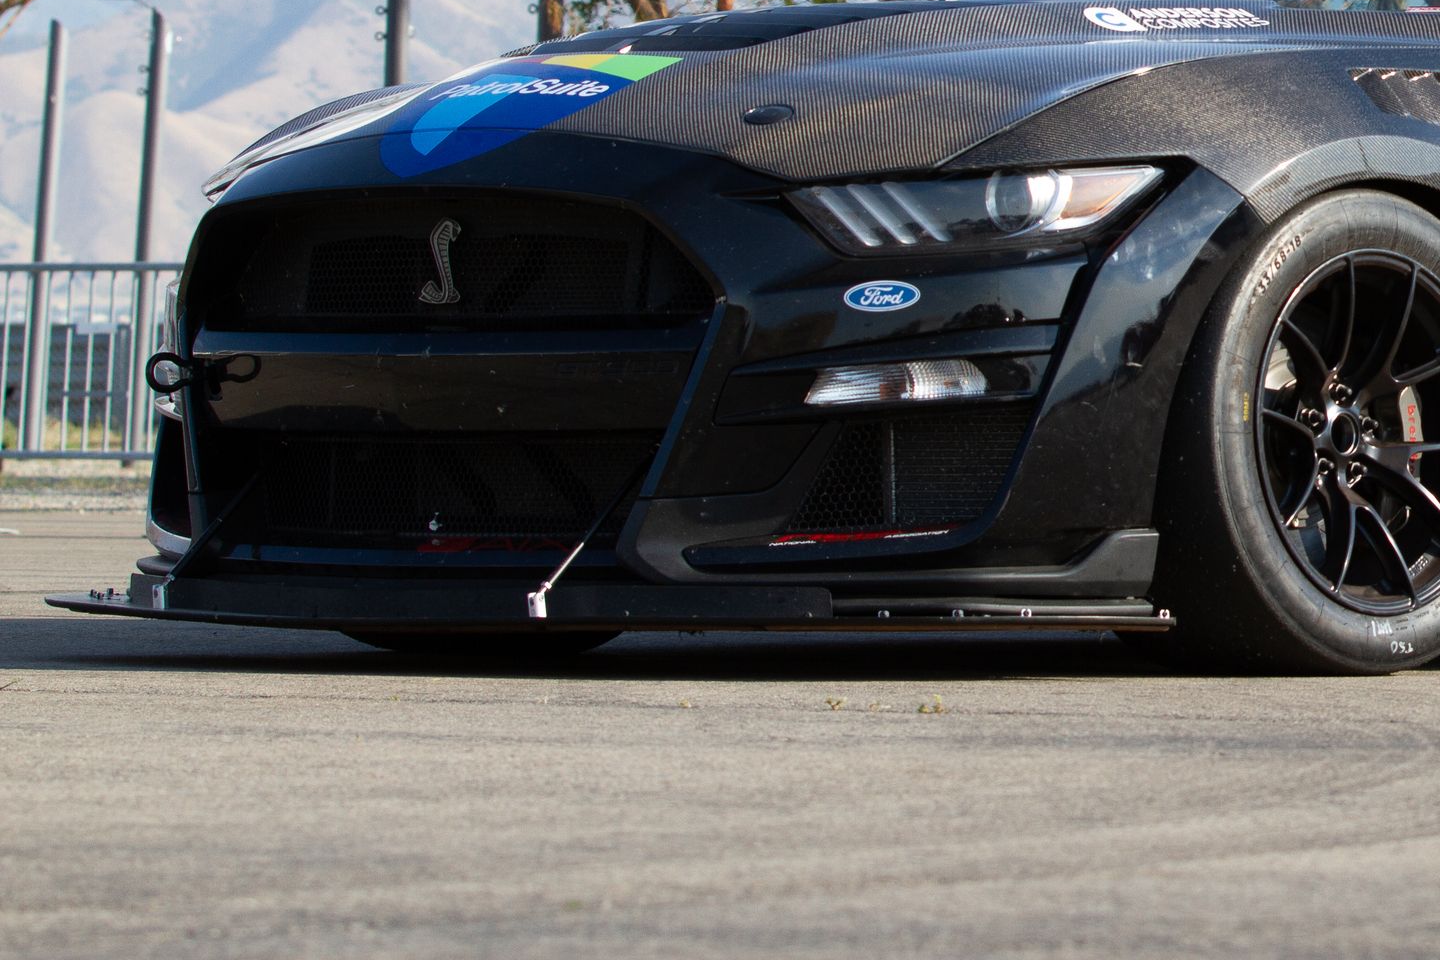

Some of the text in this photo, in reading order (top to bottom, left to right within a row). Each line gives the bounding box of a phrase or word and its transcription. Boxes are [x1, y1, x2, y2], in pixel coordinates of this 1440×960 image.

[1130, 7, 1255, 19] ANDERSON
[1145, 17, 1270, 30] COMPOSITES
[860, 286, 904, 306] Ford
[768, 539, 817, 547] NATIONAL
